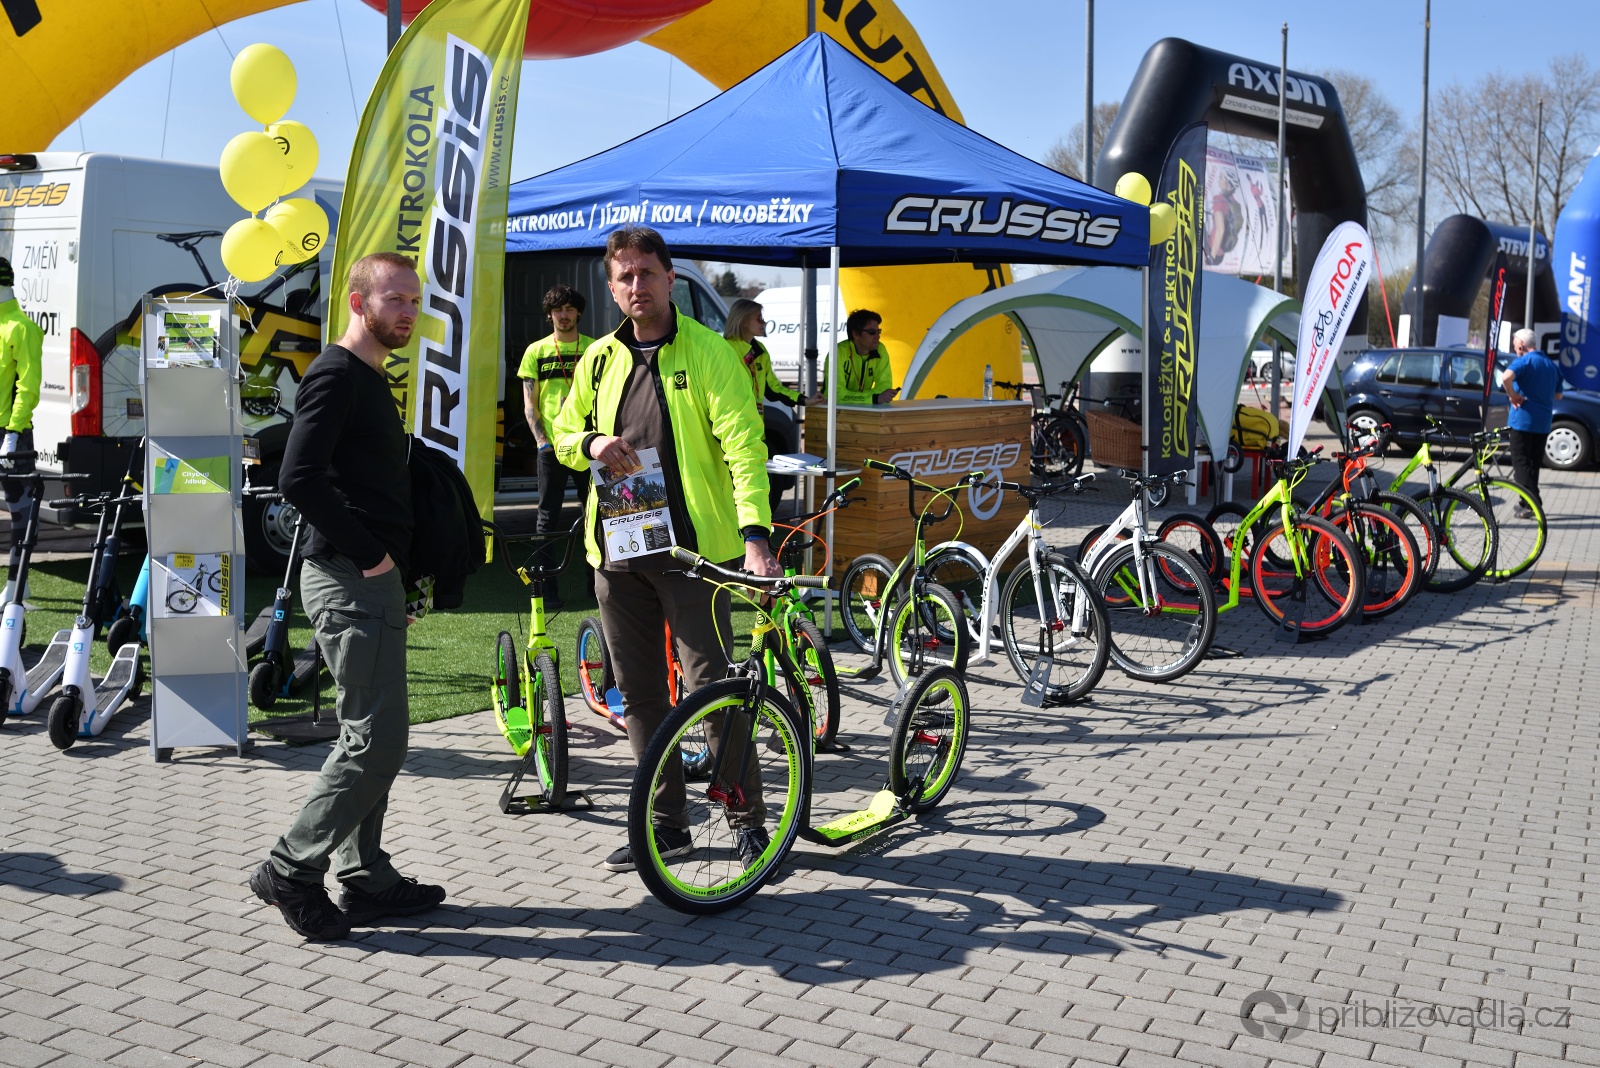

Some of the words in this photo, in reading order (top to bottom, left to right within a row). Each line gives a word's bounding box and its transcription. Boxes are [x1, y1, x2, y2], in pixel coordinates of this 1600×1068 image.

[488, 75, 510, 190] www.crussis.cz
[1284, 110, 1321, 125] quipment
[599, 200, 649, 229] JÍZDNÍ
[651, 204, 692, 223] KOLA
[710, 197, 814, 224] KOLOBĚŽKY
[22, 240, 59, 269] ZMĚŇ
[21, 271, 49, 303] SVŮJ
[1565, 251, 1587, 345] GIANT
[1158, 350, 1174, 459] KOLOBĚŽKY
[181, 471, 210, 479] Citybug
